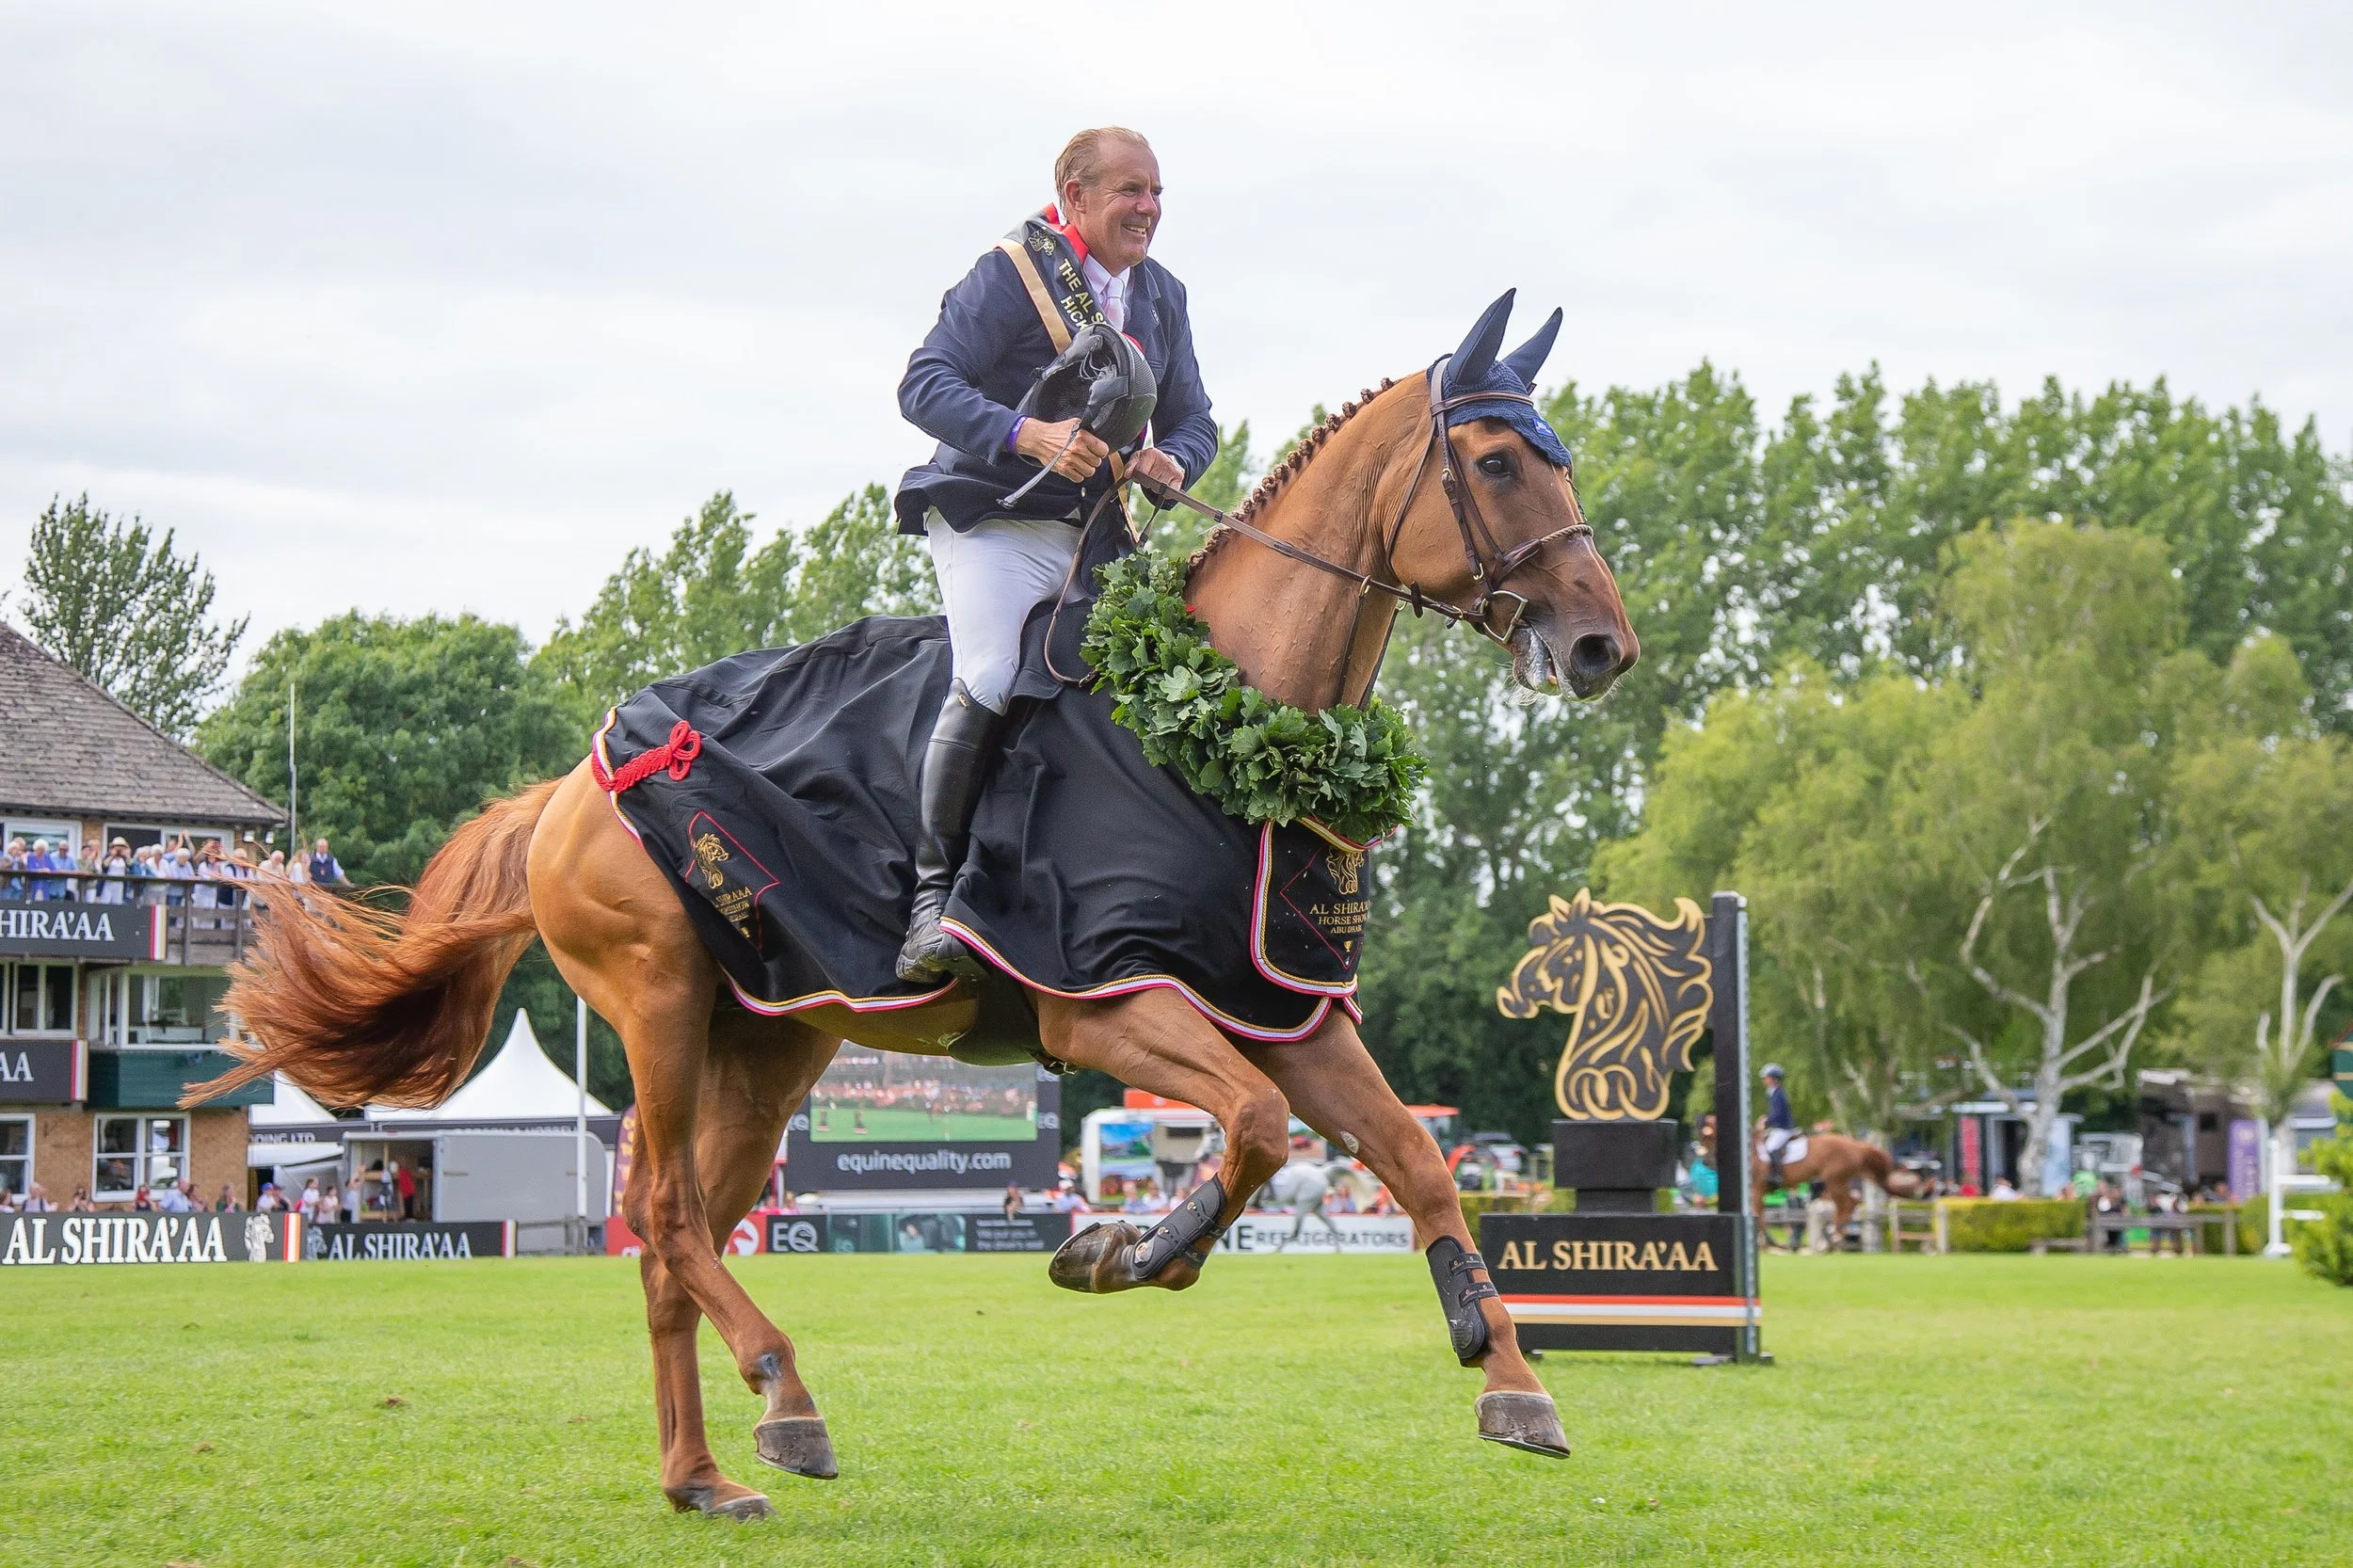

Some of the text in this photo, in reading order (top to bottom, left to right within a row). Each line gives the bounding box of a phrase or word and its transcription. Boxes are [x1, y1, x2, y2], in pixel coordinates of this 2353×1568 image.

[1059, 258, 1107, 324] THE AL S
[1309, 904, 1329, 915] AL
[1319, 916, 1351, 925] HORSE
[1331, 925, 1346, 934] ABU
[837, 1149, 1012, 1175] equinequality.com
[2, 1216, 228, 1264] AL SHIRA'AA
[329, 1232, 472, 1260] AL SHIRA'AA
[773, 1221, 819, 1252] EQ
[1497, 1240, 1547, 1270] AL
[1552, 1240, 1720, 1271] SHIRA'AA
